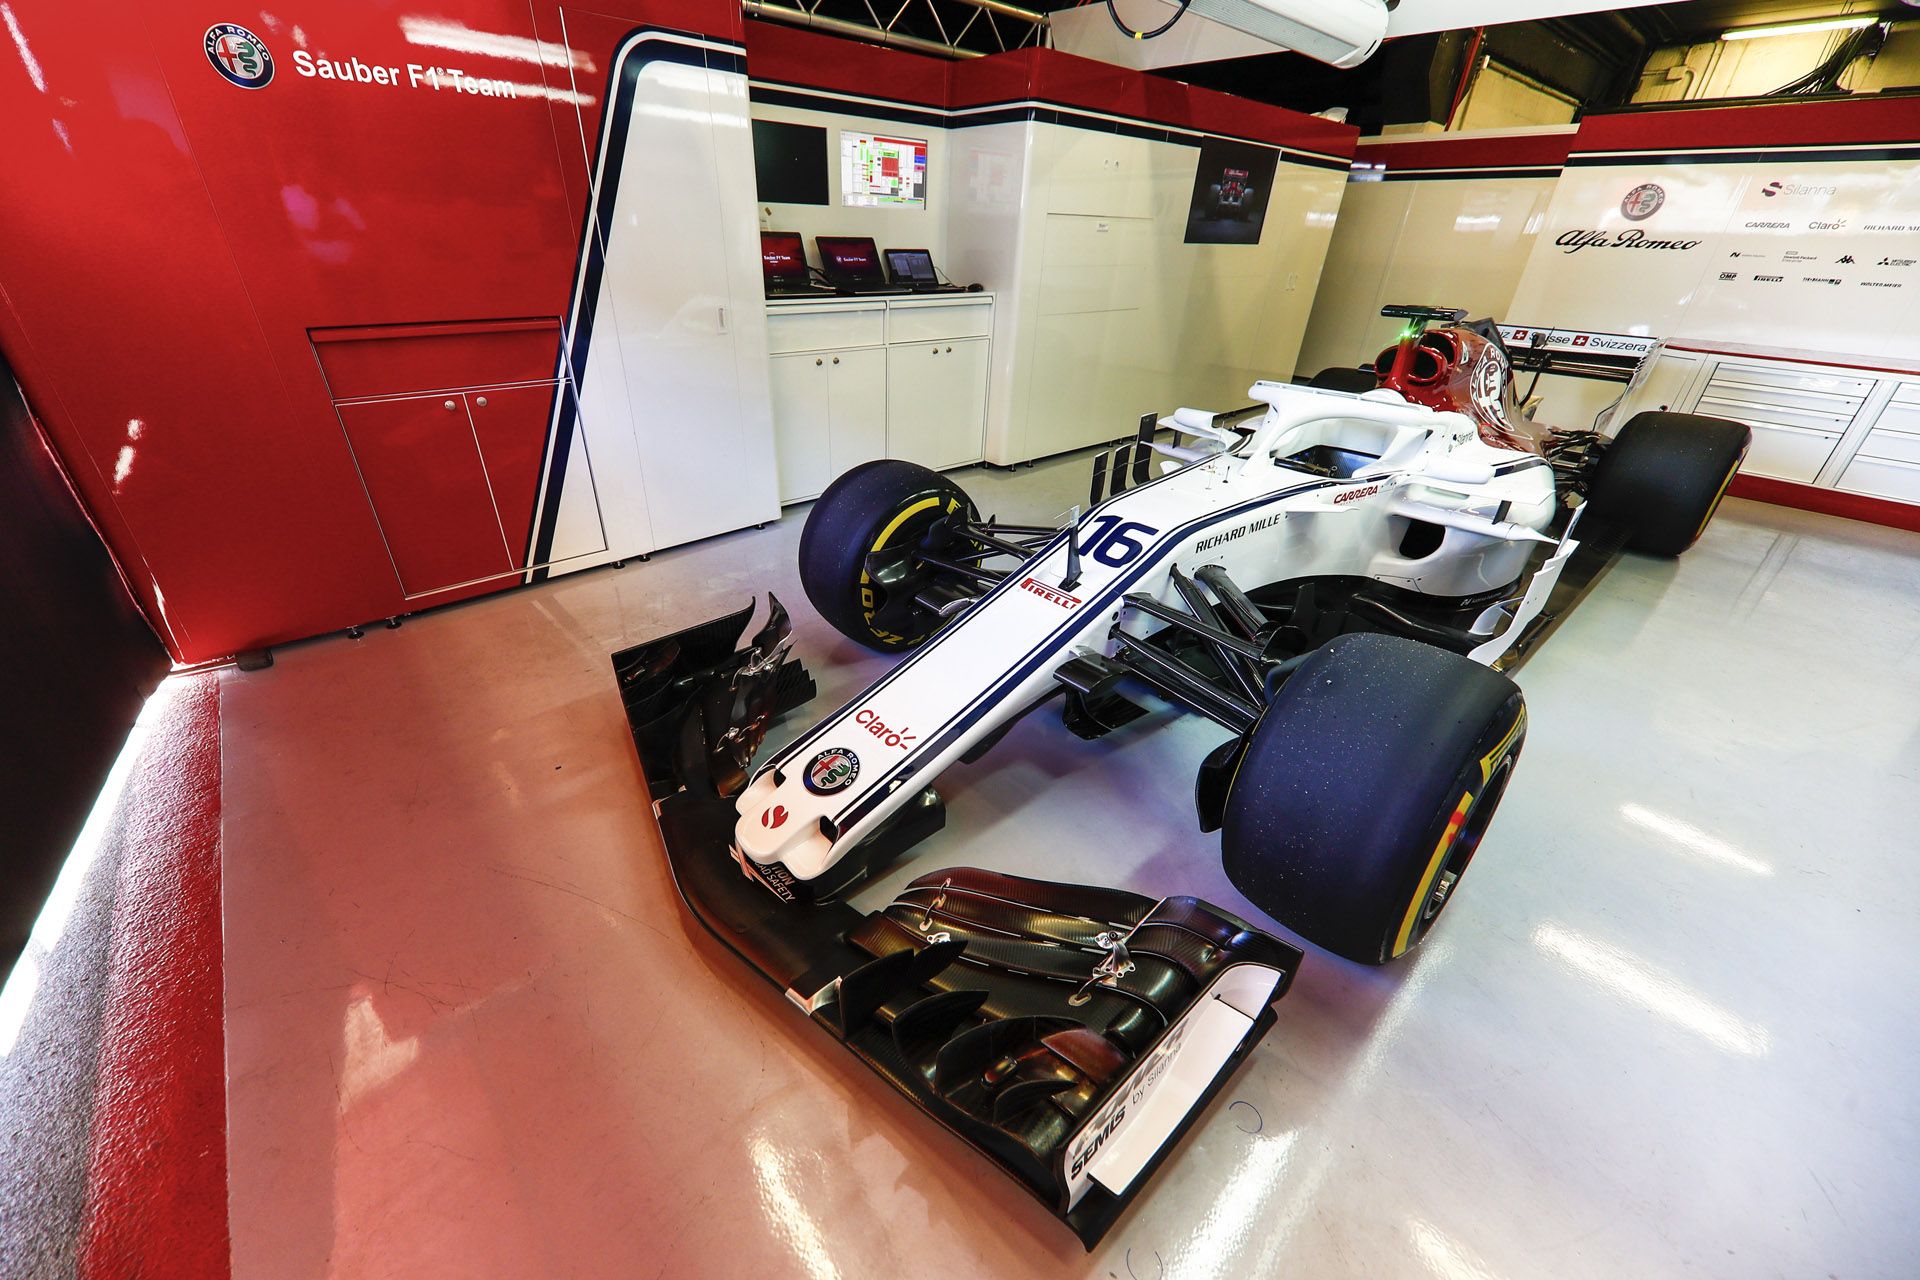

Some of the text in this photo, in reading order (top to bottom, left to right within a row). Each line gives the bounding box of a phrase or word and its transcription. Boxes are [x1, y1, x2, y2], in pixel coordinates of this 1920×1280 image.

[207, 26, 270, 61] ALFA ROMEO
[292, 49, 400, 86] Sauber
[446, 68, 518, 99] Team
[1783, 183, 1838, 196] Silanna
[1744, 219, 1844, 231] CARRERA Claro
[1555, 229, 1703, 255] Alfa Romeo
[1719, 272, 1737, 280] OMP
[1589, 337, 1648, 352] Svizzera
[1333, 484, 1379, 505] CARRERA
[1078, 514, 1160, 570] 16
[1195, 512, 1281, 554] RICHARD MILLE
[1019, 576, 1082, 610] PIRELLI
[855, 708, 909, 749] Claro
[816, 748, 860, 786] ALFA ROMEO
[767, 871, 796, 902] SAFETY
[770, 864, 796, 887] TION
[1132, 1086, 1145, 1105] by
[1147, 1042, 1183, 1088] Silanna
